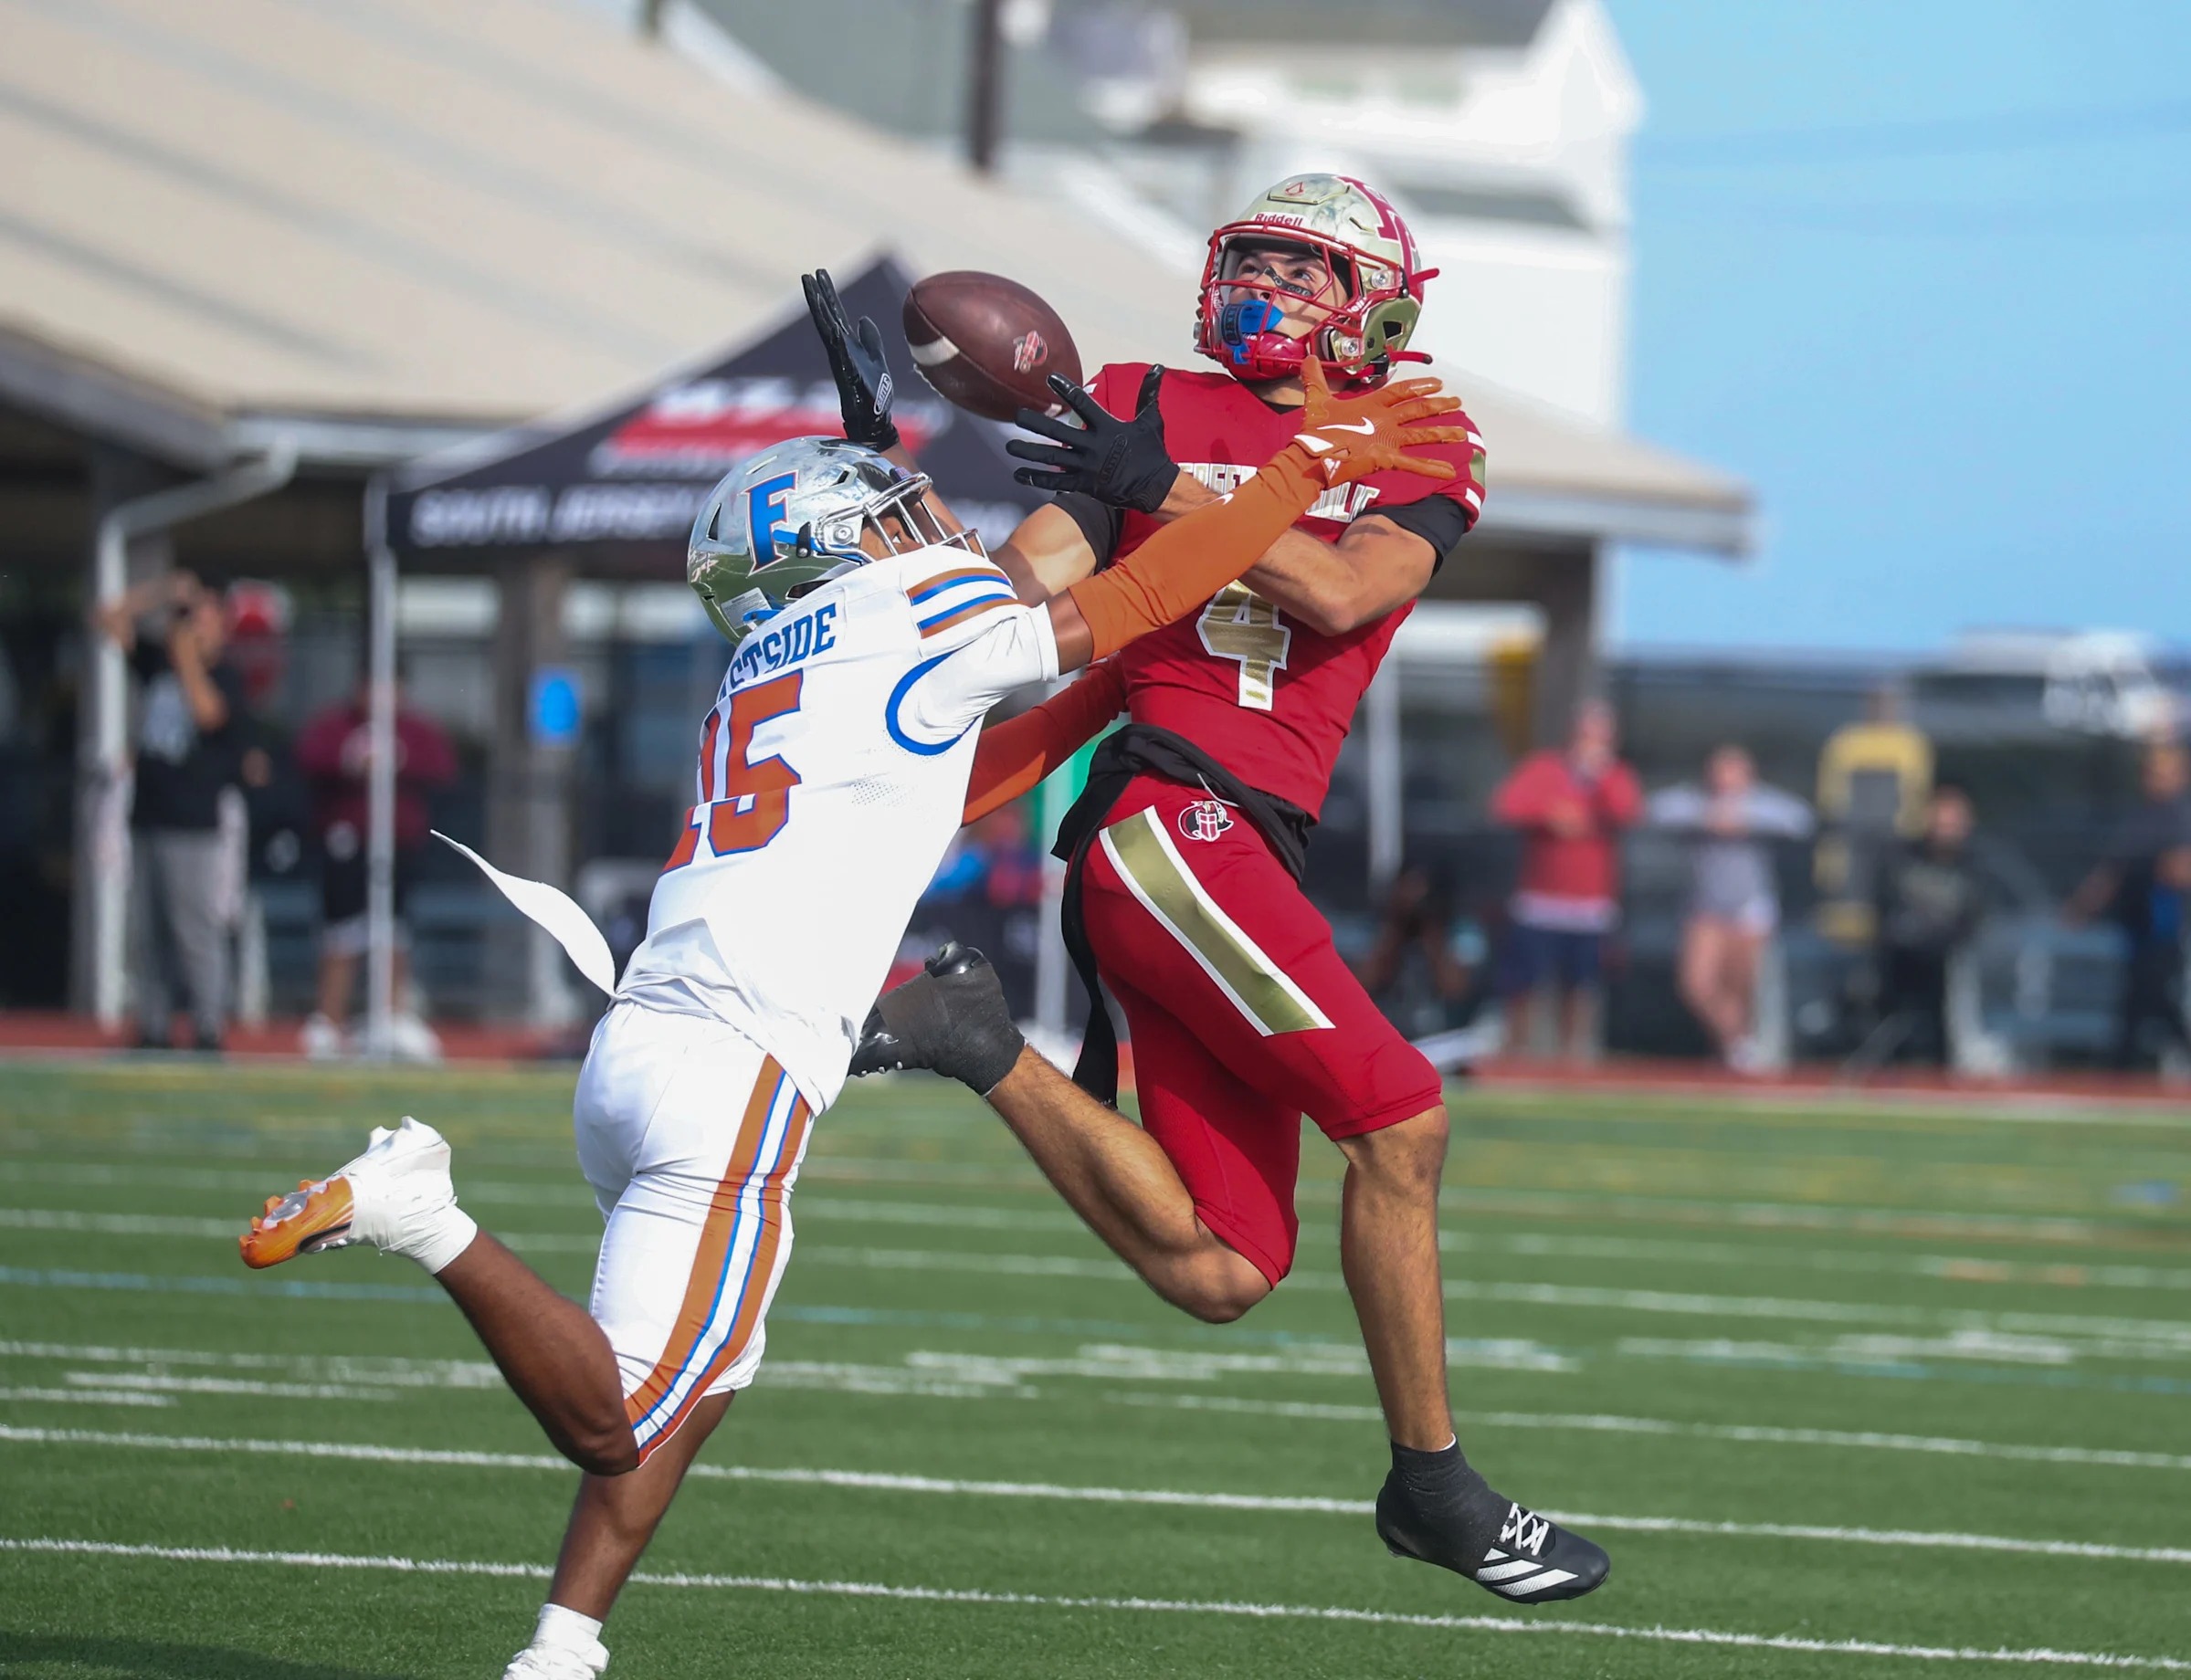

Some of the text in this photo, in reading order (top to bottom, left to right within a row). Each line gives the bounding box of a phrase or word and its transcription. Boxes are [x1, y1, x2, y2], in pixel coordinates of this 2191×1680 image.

[1254, 213, 1303, 226] Riddell
[741, 469, 800, 577] F
[1195, 578, 1291, 711] 4
